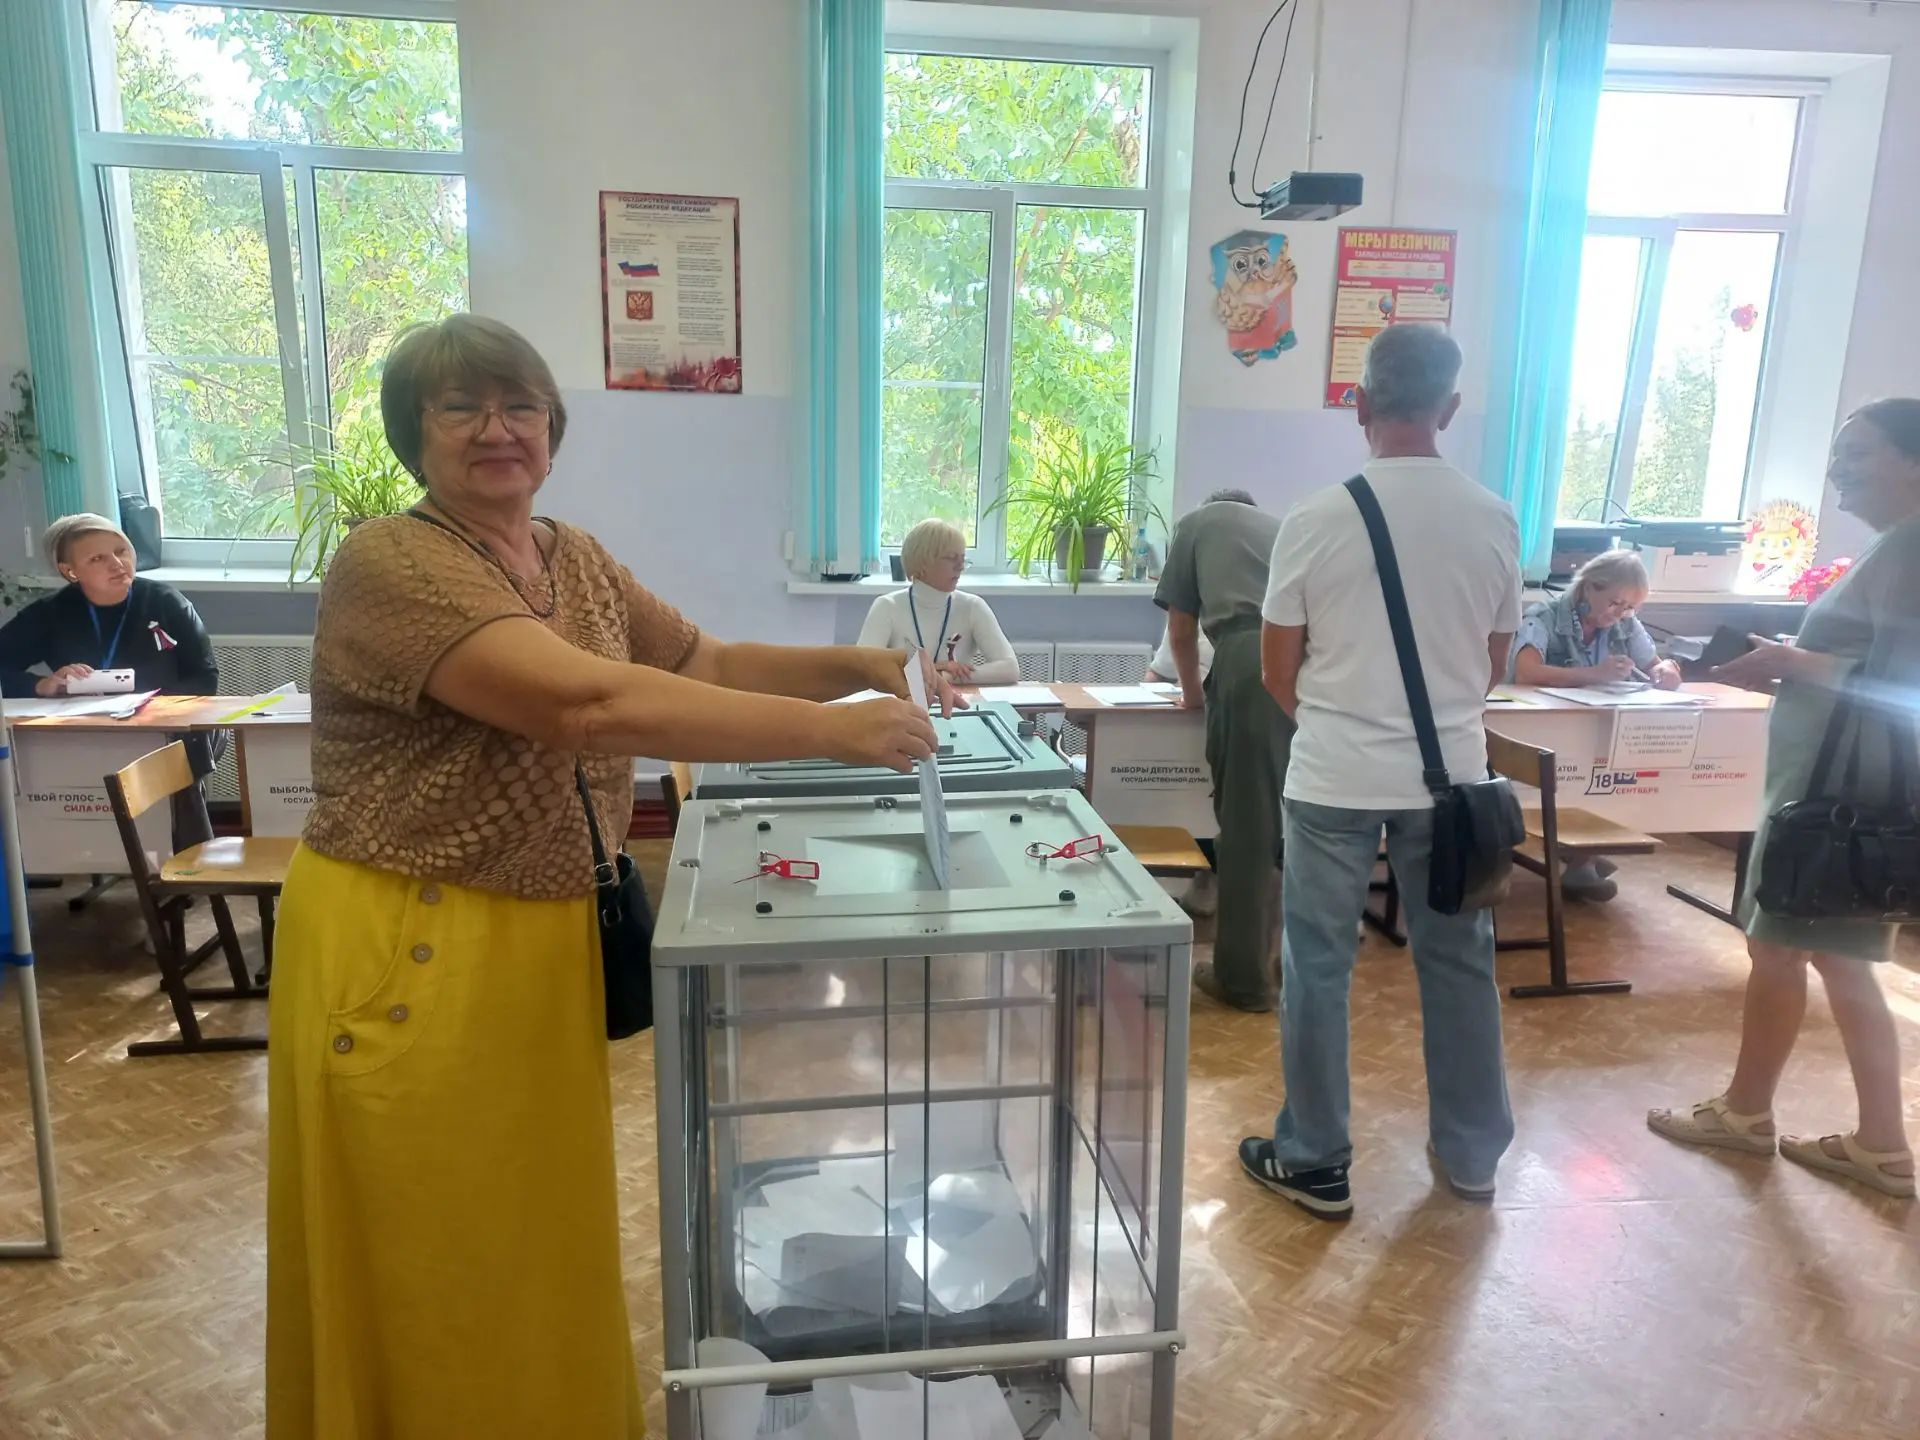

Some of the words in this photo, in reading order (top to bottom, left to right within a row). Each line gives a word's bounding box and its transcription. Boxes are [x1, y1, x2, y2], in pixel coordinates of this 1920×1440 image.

[1345, 231, 1388, 249] МЕРЫ
[1390, 233, 1450, 251] ВЕЛИЧИН
[1111, 766, 1149, 774] ВЫБОРЫ
[1151, 766, 1200, 774] ДЕПУТАТОВ
[1595, 774, 1612, 789] 18
[27, 793, 56, 802] ТВОЙ
[59, 794, 95, 802] ГОЛОС
[64, 804, 93, 812] СИЛА
